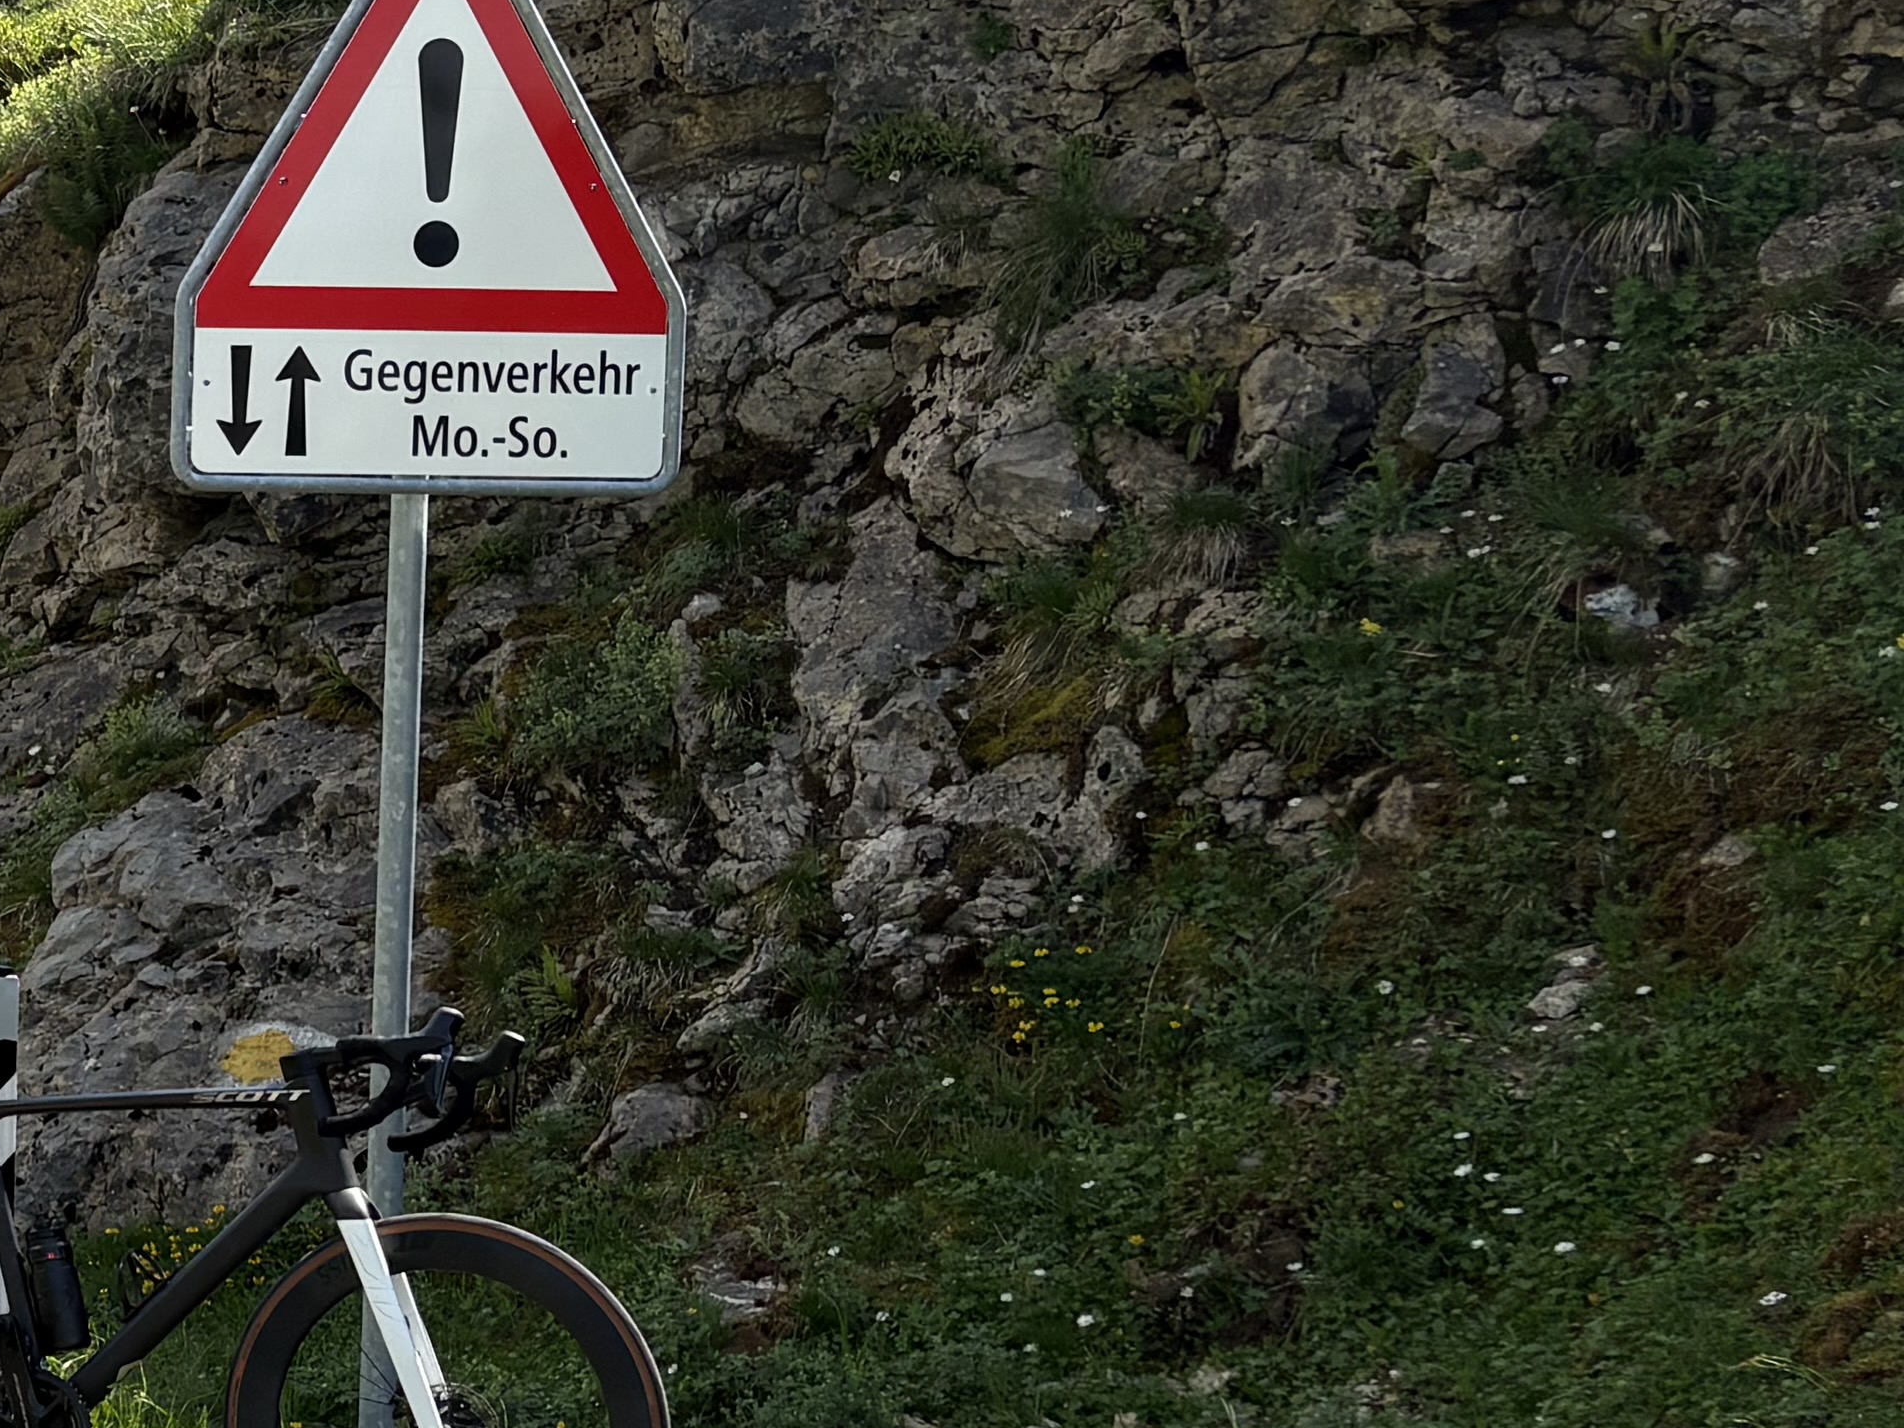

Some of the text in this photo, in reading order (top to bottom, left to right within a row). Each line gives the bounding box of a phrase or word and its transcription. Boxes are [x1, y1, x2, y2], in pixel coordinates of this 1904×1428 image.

[344, 348, 641, 404] Gegenverkehr
[411, 414, 568, 459] Mo.-So.
[190, 1088, 311, 1104] SCOTT
